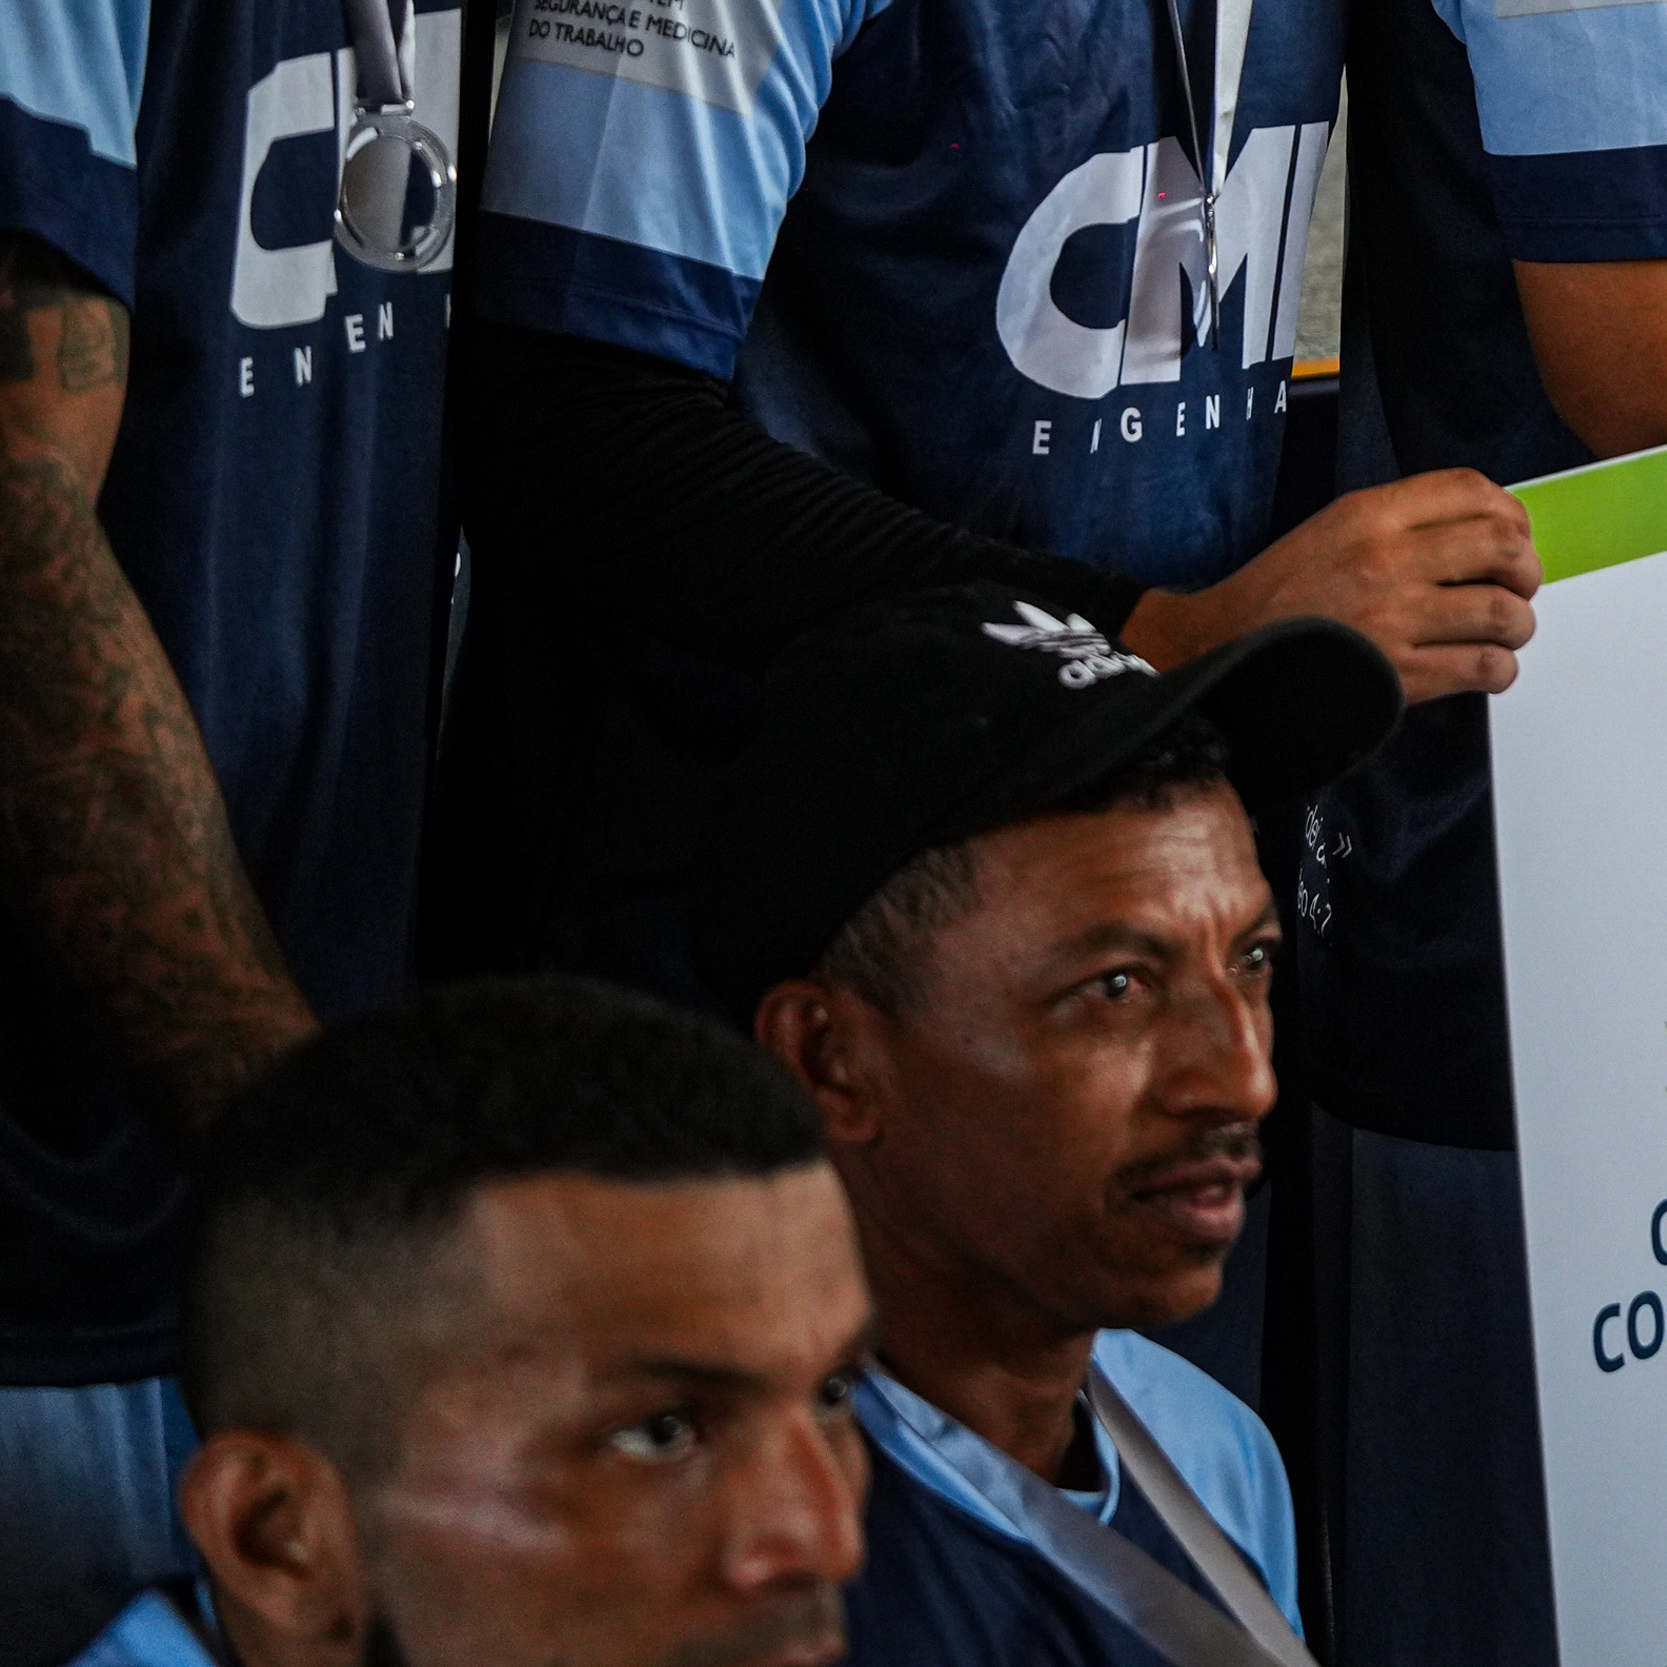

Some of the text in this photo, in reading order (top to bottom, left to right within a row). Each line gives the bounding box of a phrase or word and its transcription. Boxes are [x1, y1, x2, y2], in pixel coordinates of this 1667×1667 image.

[529, 18, 644, 57] DO TRABALHO
[628, 9, 641, 28] E
[646, 16, 736, 59] MEDICINA
